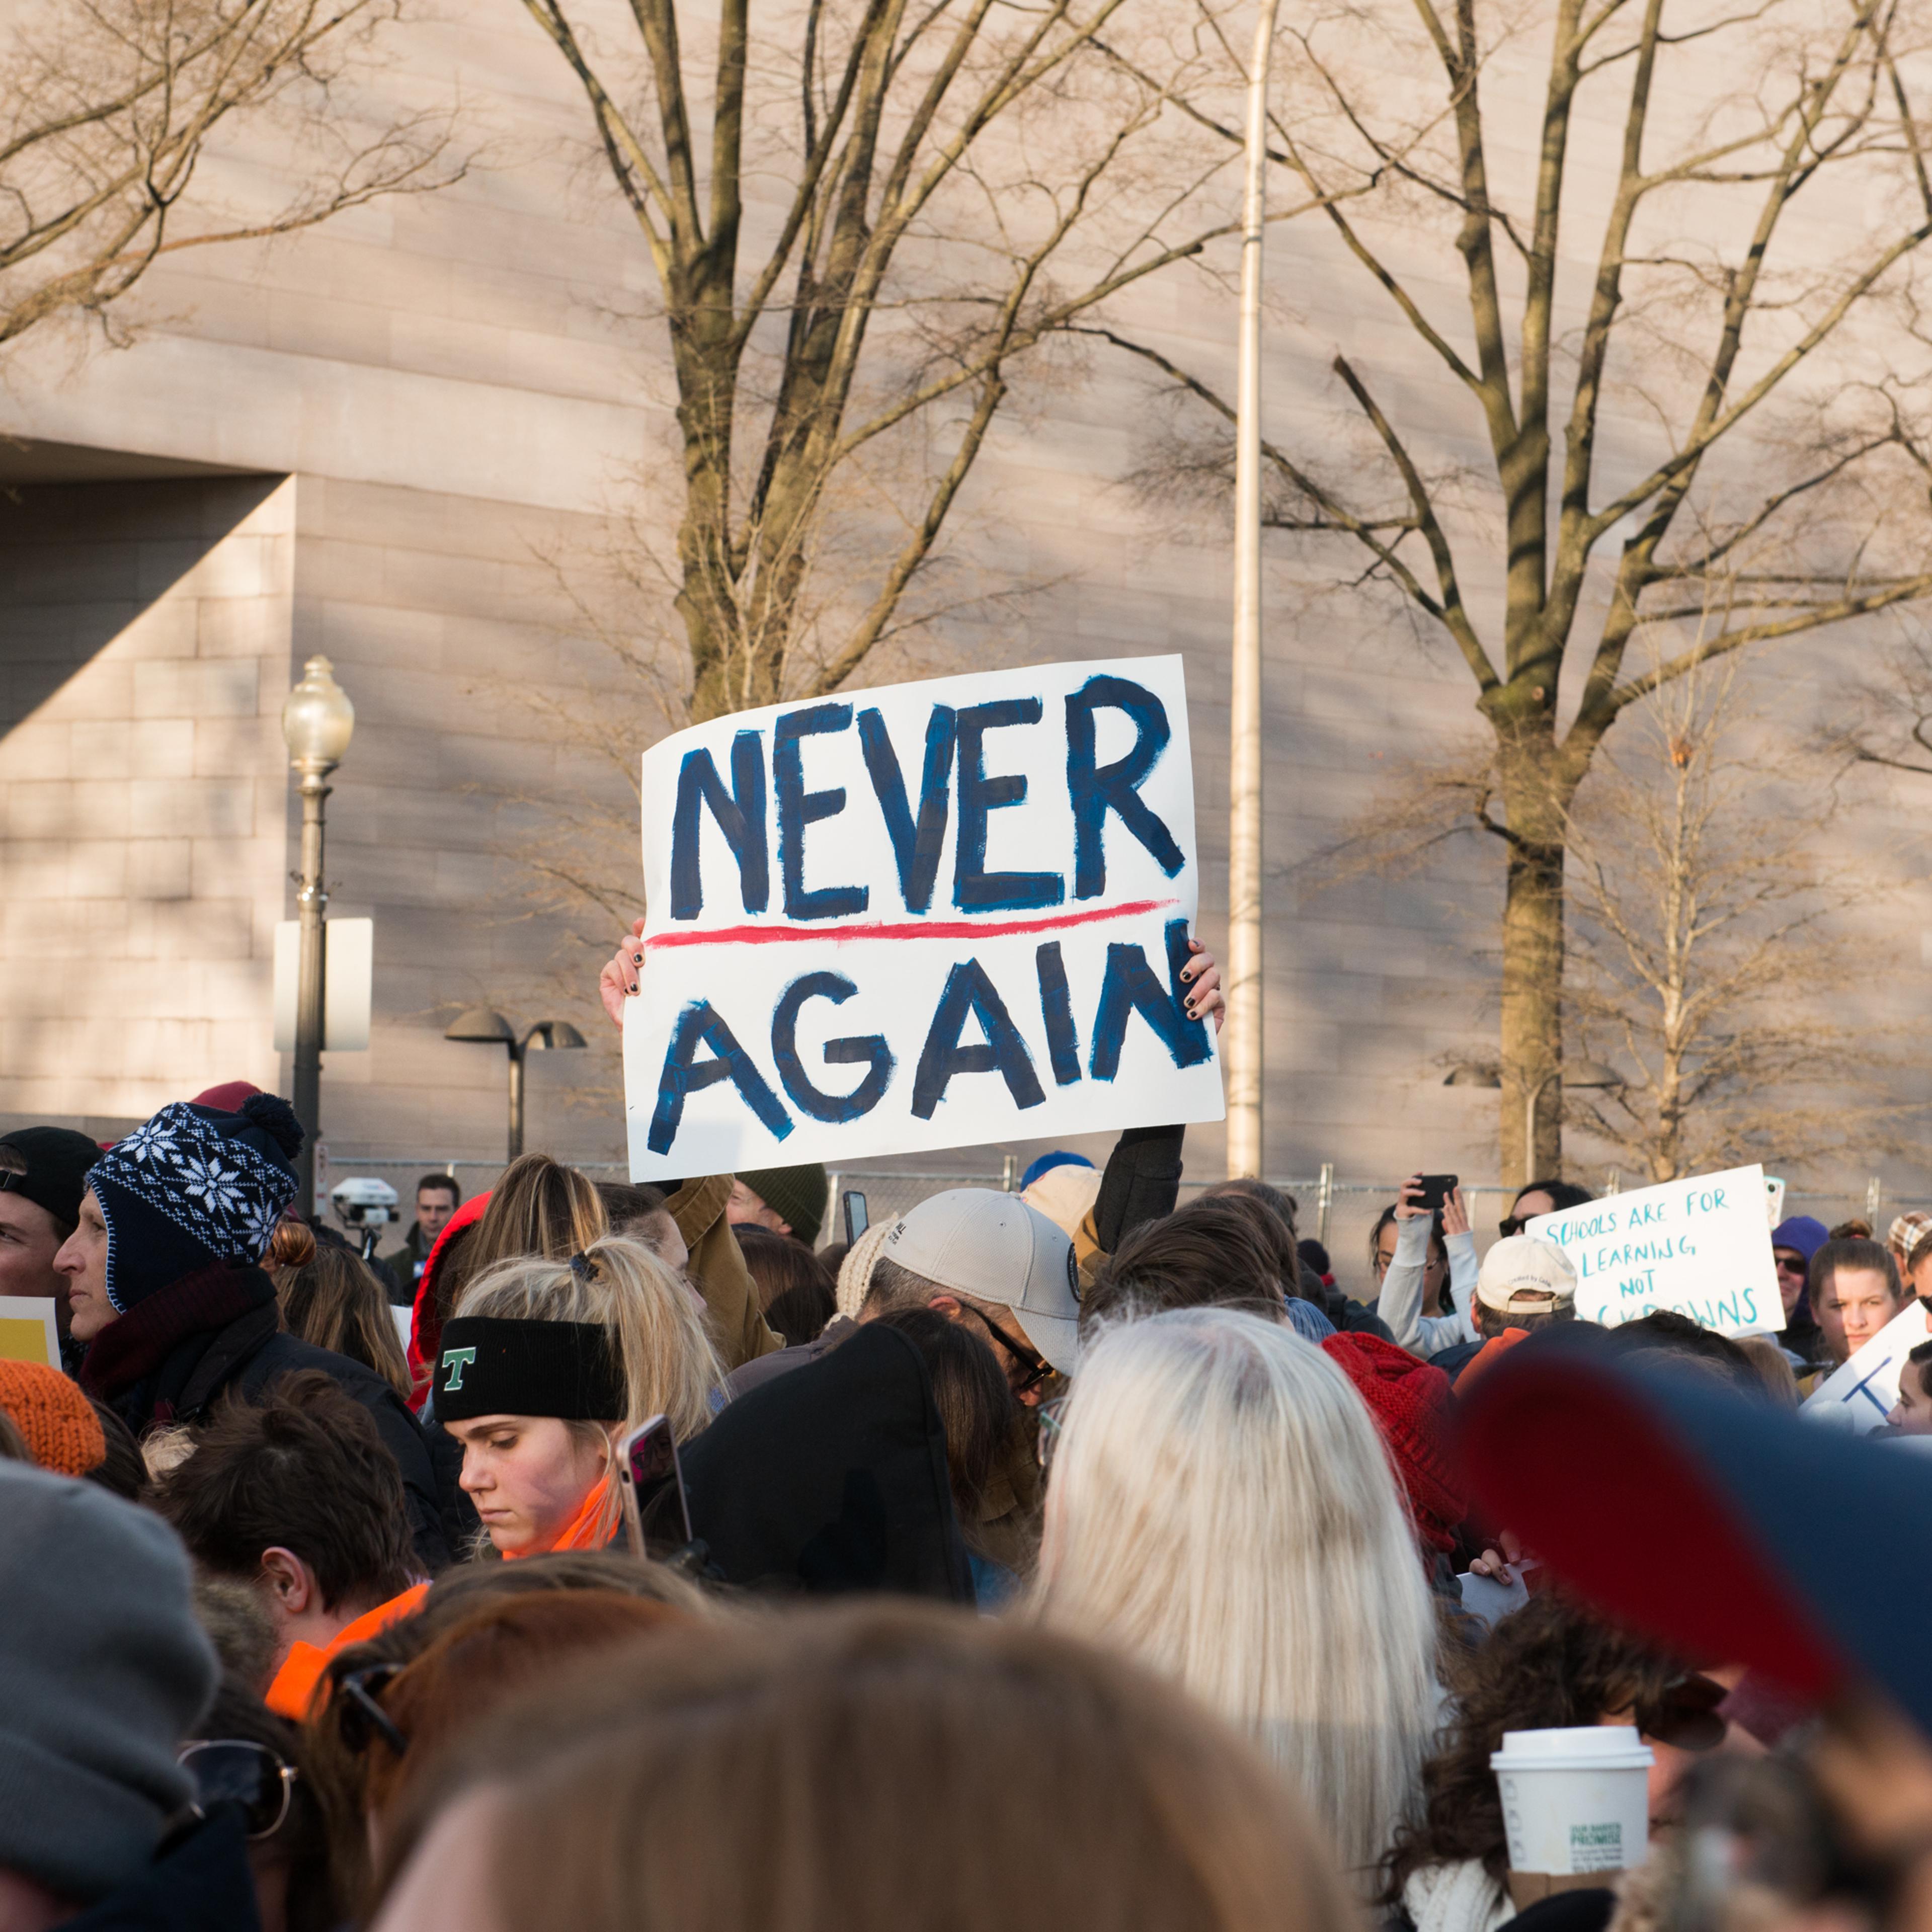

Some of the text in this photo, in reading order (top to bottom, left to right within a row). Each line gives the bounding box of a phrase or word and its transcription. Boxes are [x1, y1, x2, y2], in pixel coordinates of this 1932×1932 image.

[670, 673, 1186, 921] NEVER
[647, 918, 1214, 1156] AGAIN
[1546, 1188, 1729, 1247] SCHOOLS ARE FOR
[1582, 1235, 1696, 1277] LEARNING
[1619, 1269, 1655, 1298] NOT
[442, 1346, 476, 1392] T
